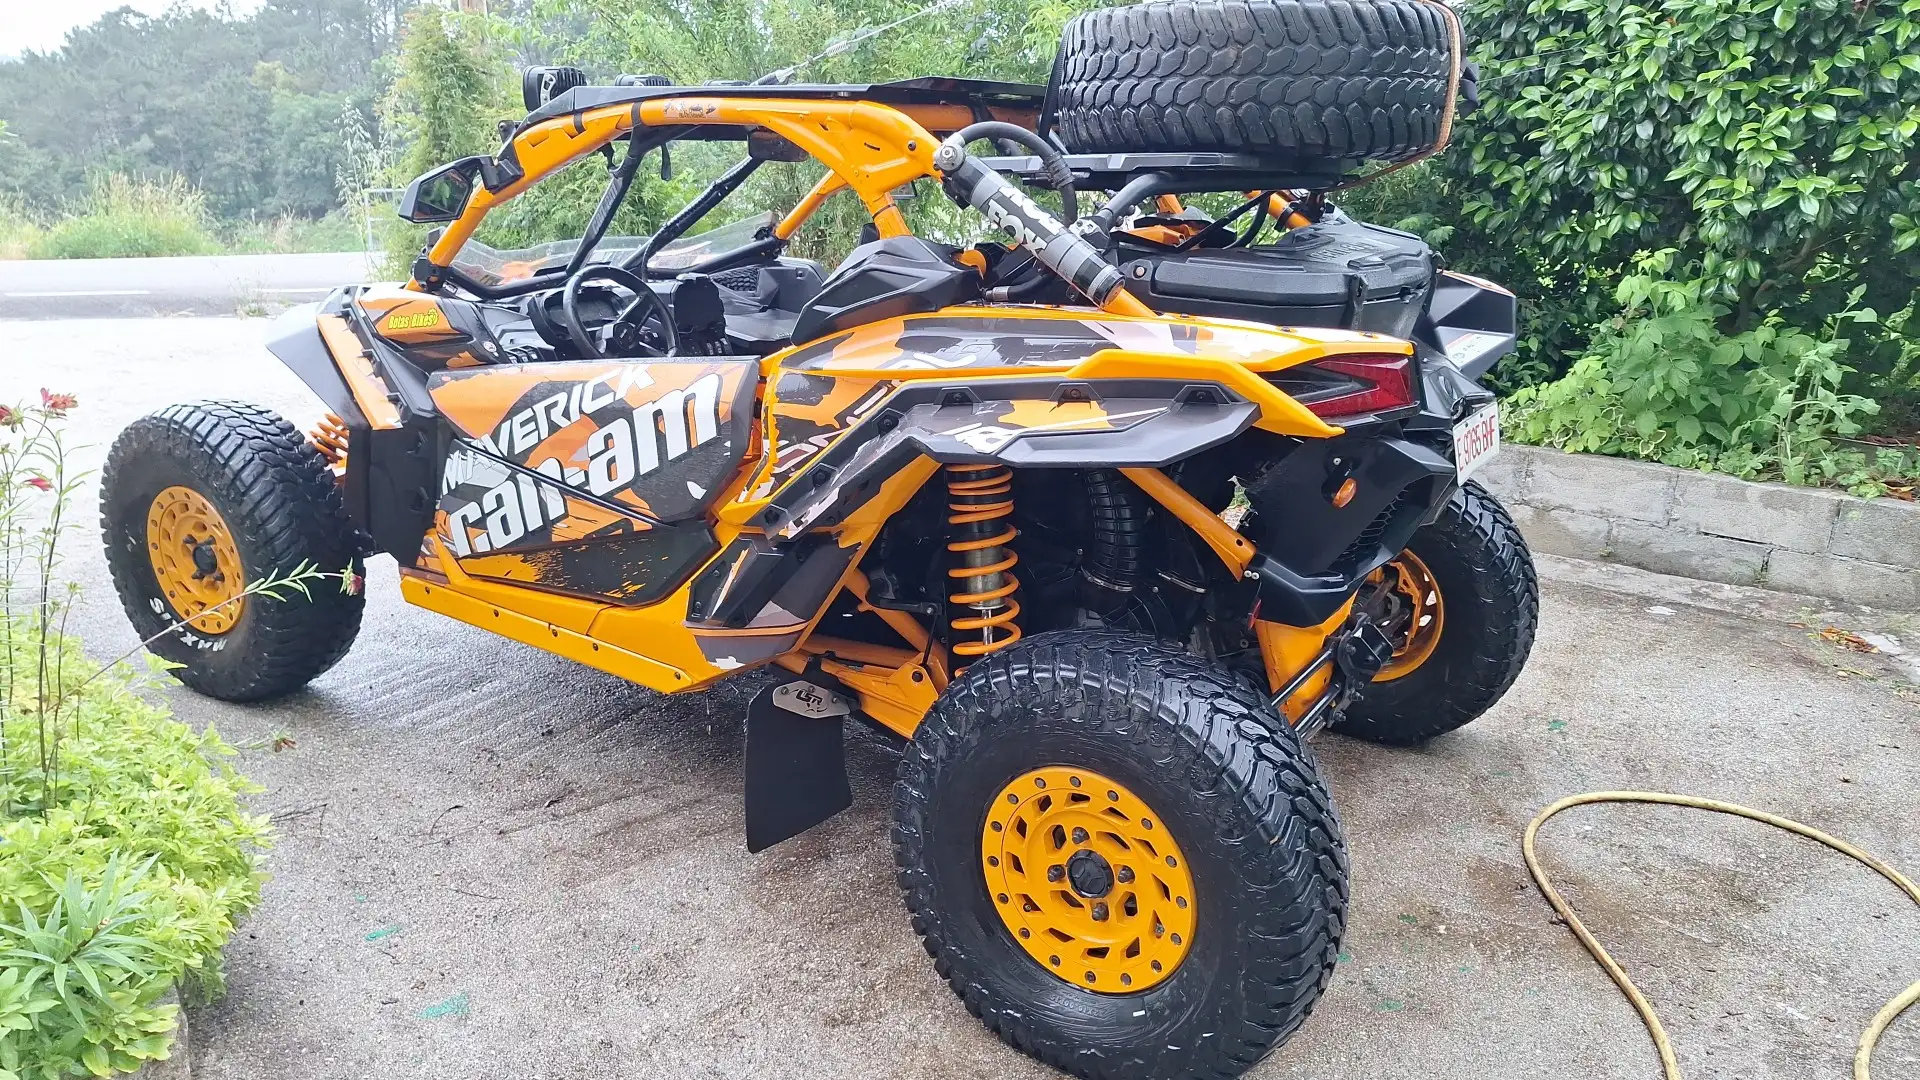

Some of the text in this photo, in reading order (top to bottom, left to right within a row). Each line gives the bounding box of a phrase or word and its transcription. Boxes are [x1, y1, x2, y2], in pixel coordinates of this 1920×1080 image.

[987, 199, 1048, 253] FOX
[388, 312, 433, 329] Botas Bikes
[449, 373, 720, 557] can-am
[1457, 438, 1464, 471] E
[1464, 424, 1482, 465] 9765
